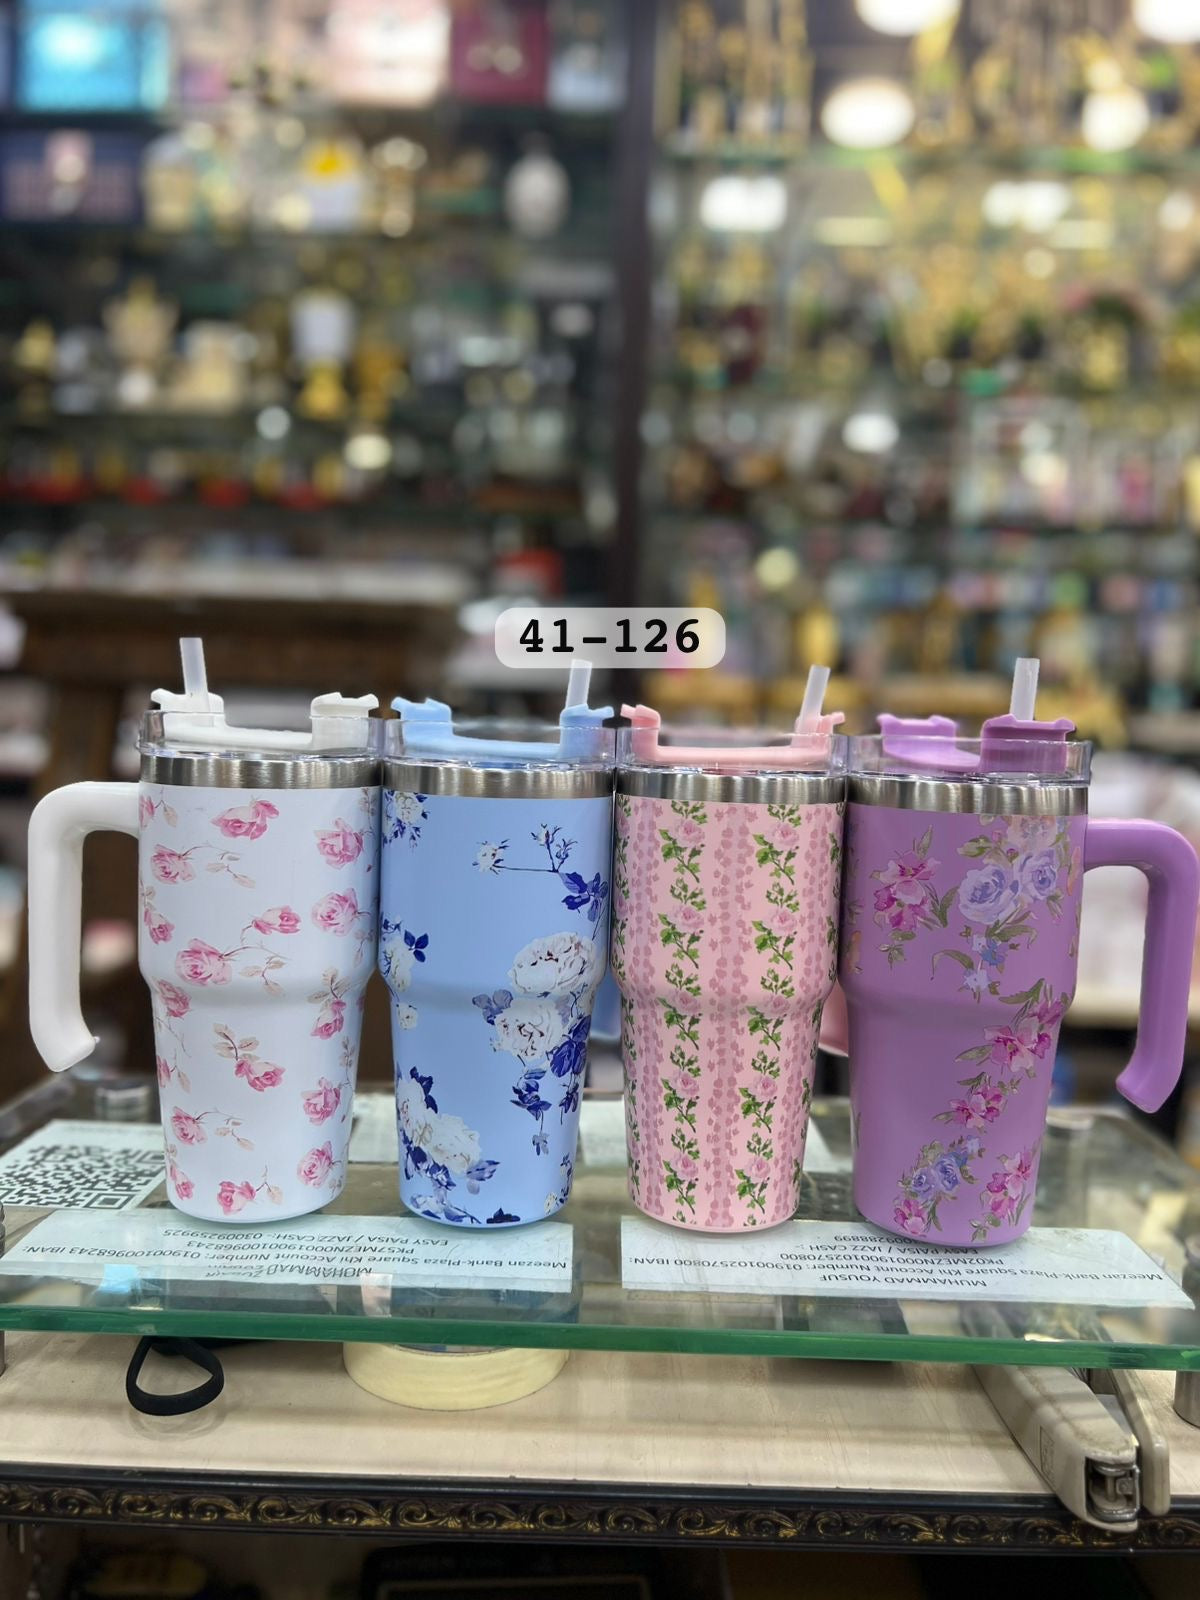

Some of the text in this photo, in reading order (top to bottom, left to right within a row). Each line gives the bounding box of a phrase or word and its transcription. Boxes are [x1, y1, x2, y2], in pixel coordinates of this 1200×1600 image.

[162, 1229, 262, 1240] 03009259925
[354, 1235, 364, 1243] /
[368, 1236, 408, 1244] PAISA
[809, 1244, 847, 1252] CASH
[896, 1247, 938, 1255] PAISA
[70, 1247, 200, 1259] 01900100968243
[204, 1253, 270, 1261] Number:
[275, 1254, 336, 1263] Account
[368, 1256, 419, 1264] Square
[424, 1258, 503, 1267] Bank-Plaza
[508, 1260, 566, 1268] Meezan
[674, 1259, 802, 1270] 01900102570800
[806, 1264, 870, 1272] Number:
[267, 1264, 372, 1278] MOHAMMAD
[874, 1266, 934, 1275] Account
[938, 1268, 961, 1276] Khi
[1020, 1269, 1099, 1280] Bank-Plaza
[820, 1274, 987, 1287] MUHAMMAD YOUSUF
